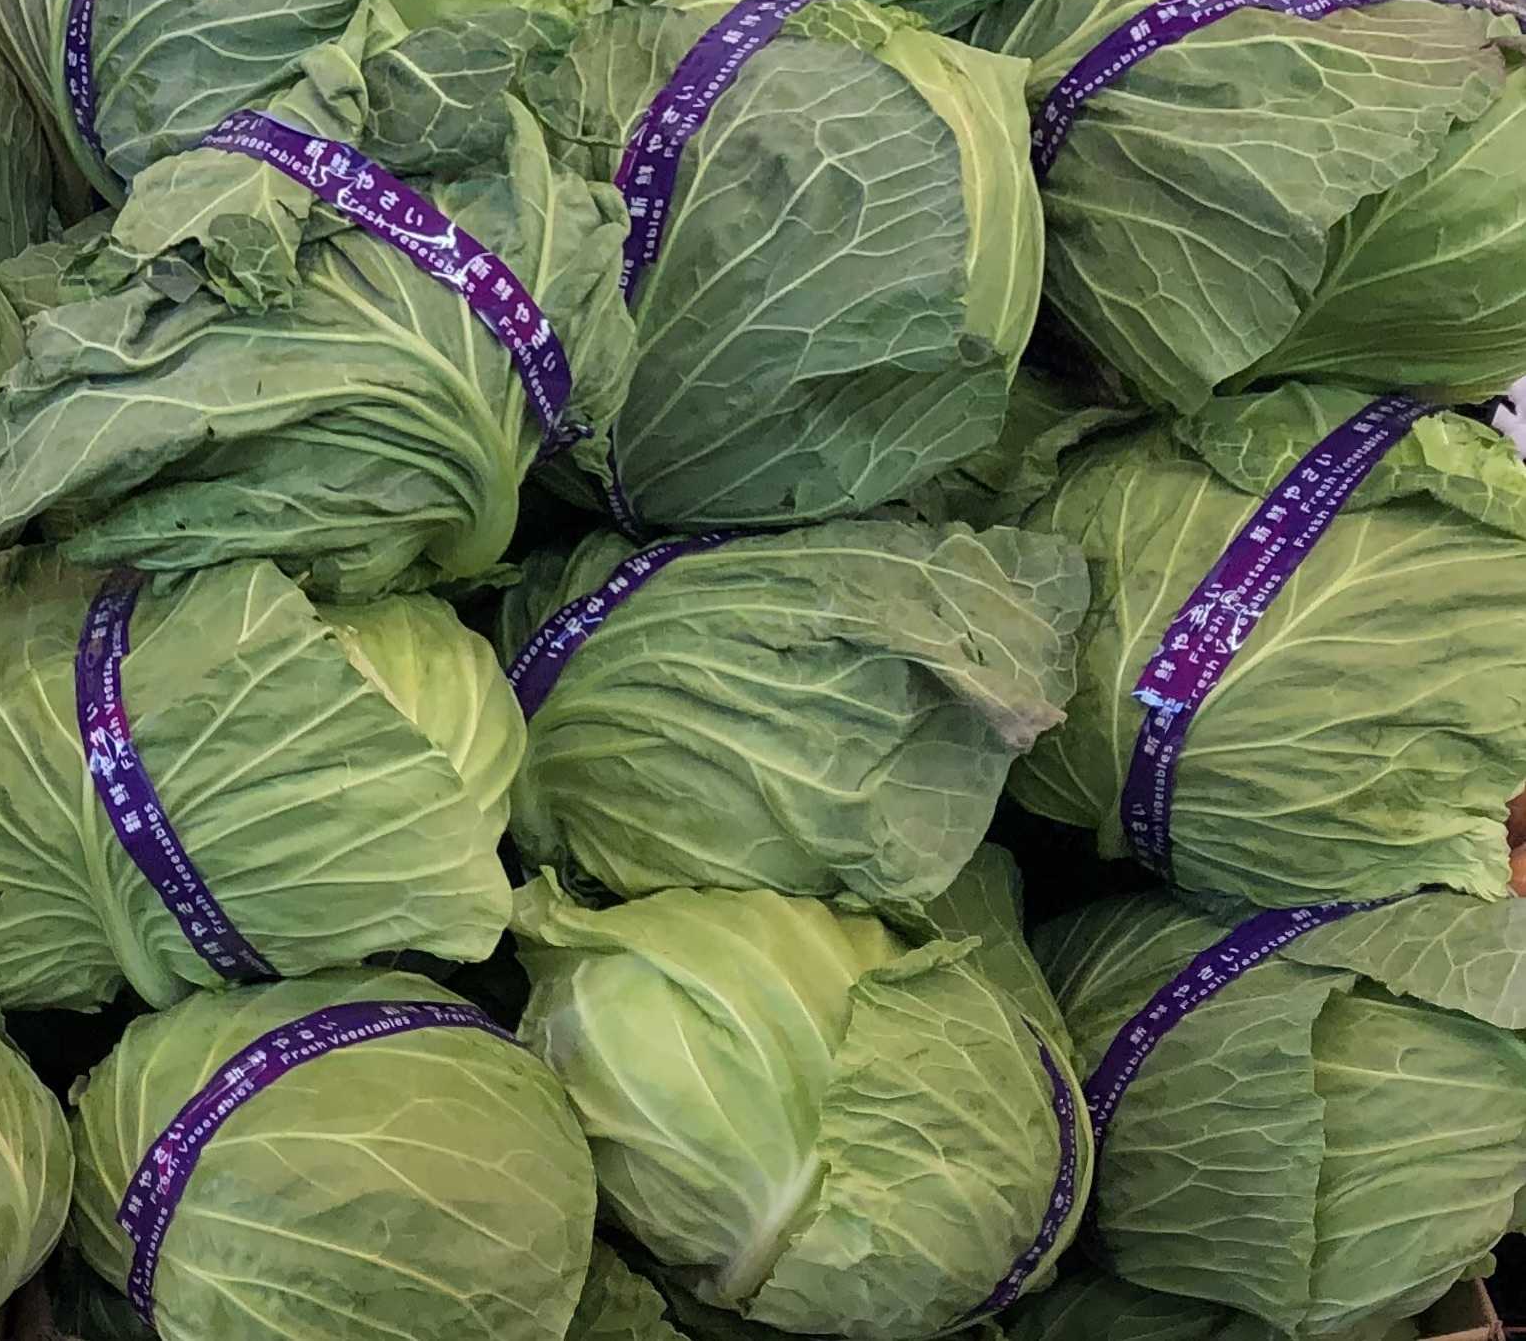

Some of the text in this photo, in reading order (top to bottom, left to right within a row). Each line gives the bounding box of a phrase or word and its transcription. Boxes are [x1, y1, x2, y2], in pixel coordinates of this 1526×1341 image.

[1250, 453, 1332, 544] 新鮮やさい
